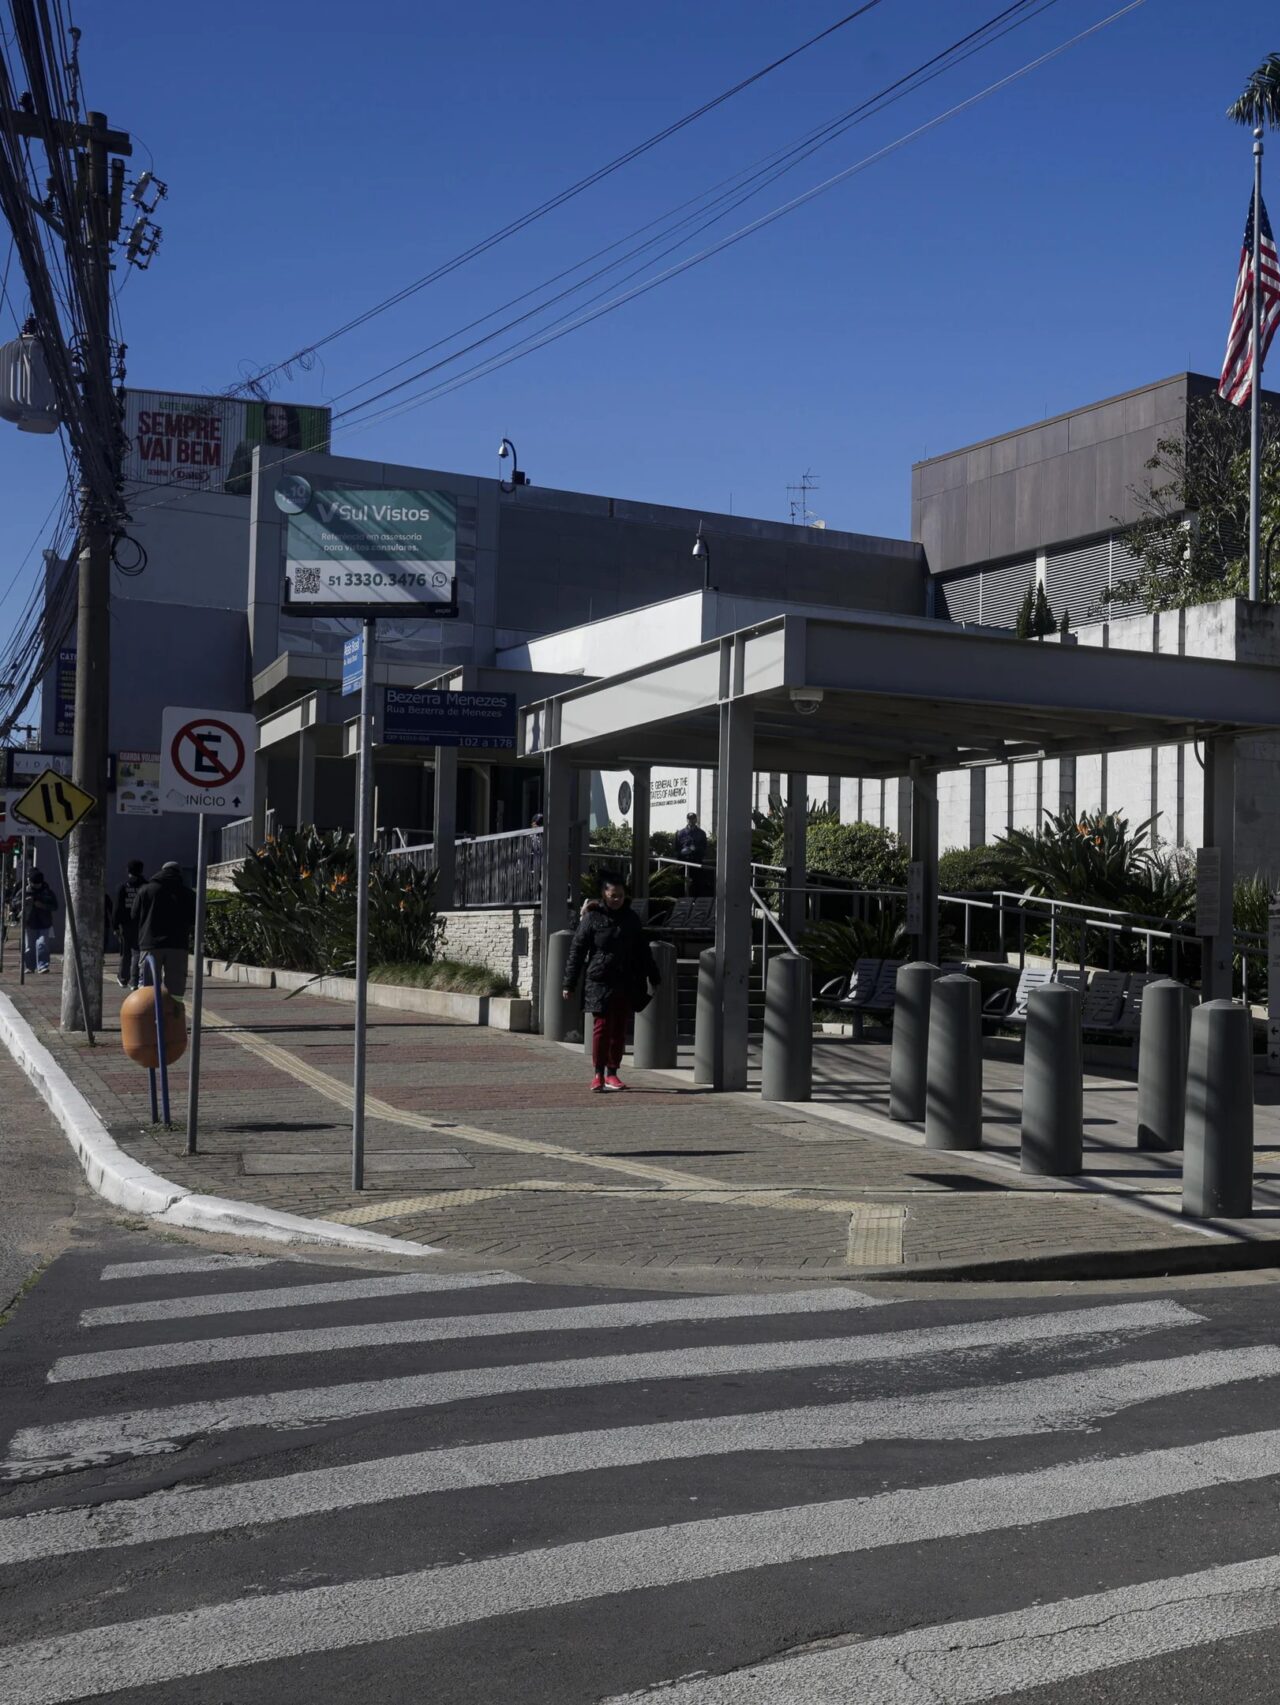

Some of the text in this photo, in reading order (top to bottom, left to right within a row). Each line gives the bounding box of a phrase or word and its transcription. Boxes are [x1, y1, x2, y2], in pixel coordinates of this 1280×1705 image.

[138, 411, 222, 441] SEMPRE
[138, 435, 221, 465] VAI BEM
[339, 505, 368, 521] Sul
[373, 505, 430, 521] Vistos
[380, 532, 422, 541] assessoria
[324, 545, 343, 553] para
[328, 573, 427, 587] 51 3330.3476
[387, 690, 508, 708] Bezerra Menezes
[386, 705, 502, 718] Rua Bezerra de Menezes
[459, 738, 479, 747] 102
[494, 738, 513, 748] 178
[673, 778, 679, 787] OF
[186, 794, 226, 807] INÍCIO
